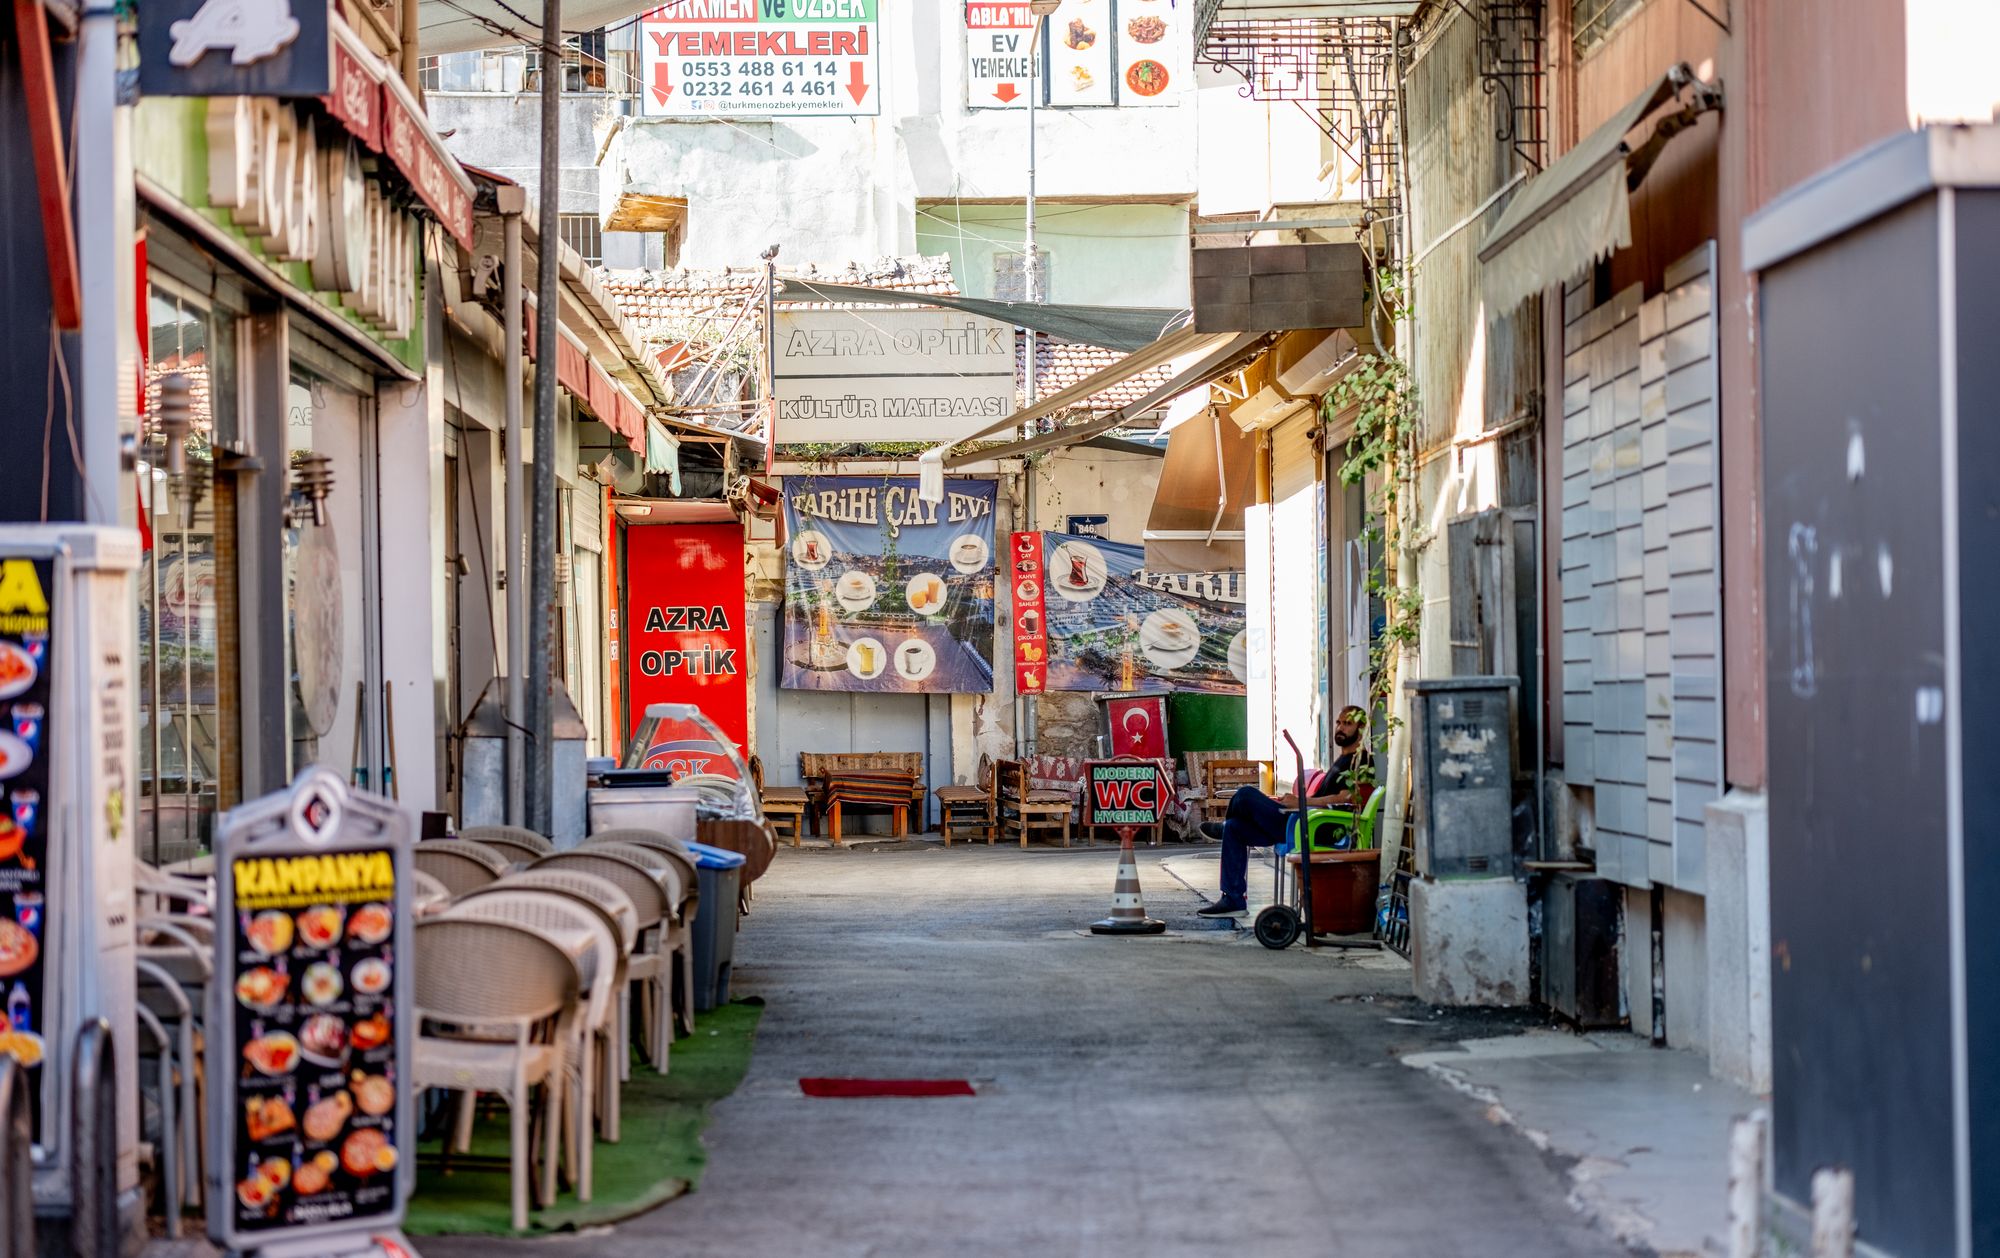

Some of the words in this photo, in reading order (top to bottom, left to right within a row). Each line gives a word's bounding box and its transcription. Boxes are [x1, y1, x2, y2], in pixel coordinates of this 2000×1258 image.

[763, 0, 785, 18] ve
[970, 7, 1033, 26] ABLA'NI
[649, 25, 868, 56] YEMEKLERİ
[992, 34, 1019, 52] EV
[682, 62, 731, 76] 0553
[738, 61, 774, 76] 488
[782, 61, 804, 76] 61
[814, 61, 837, 76] 14
[972, 52, 1040, 78] YEMEKLEİ
[683, 81, 732, 96] 0232
[739, 81, 773, 96] 461
[782, 81, 794, 96] 4
[801, 81, 836, 96] 461
[719, 100, 843, 111] @turkmenozbekyemekleri
[786, 329, 885, 357] AZRA
[893, 322, 1005, 355] OPTİK
[779, 395, 877, 419] KÜLTÜR
[883, 397, 1008, 417] MATBAASI
[886, 486, 938, 538] ÇAY
[644, 605, 730, 633] AZRA
[639, 643, 737, 676] OPTİK
[1094, 767, 1155, 780] MODERN
[1094, 781, 1155, 809] WC
[1094, 810, 1155, 823] HYGIENA
[234, 851, 395, 897] KAMPANYA
